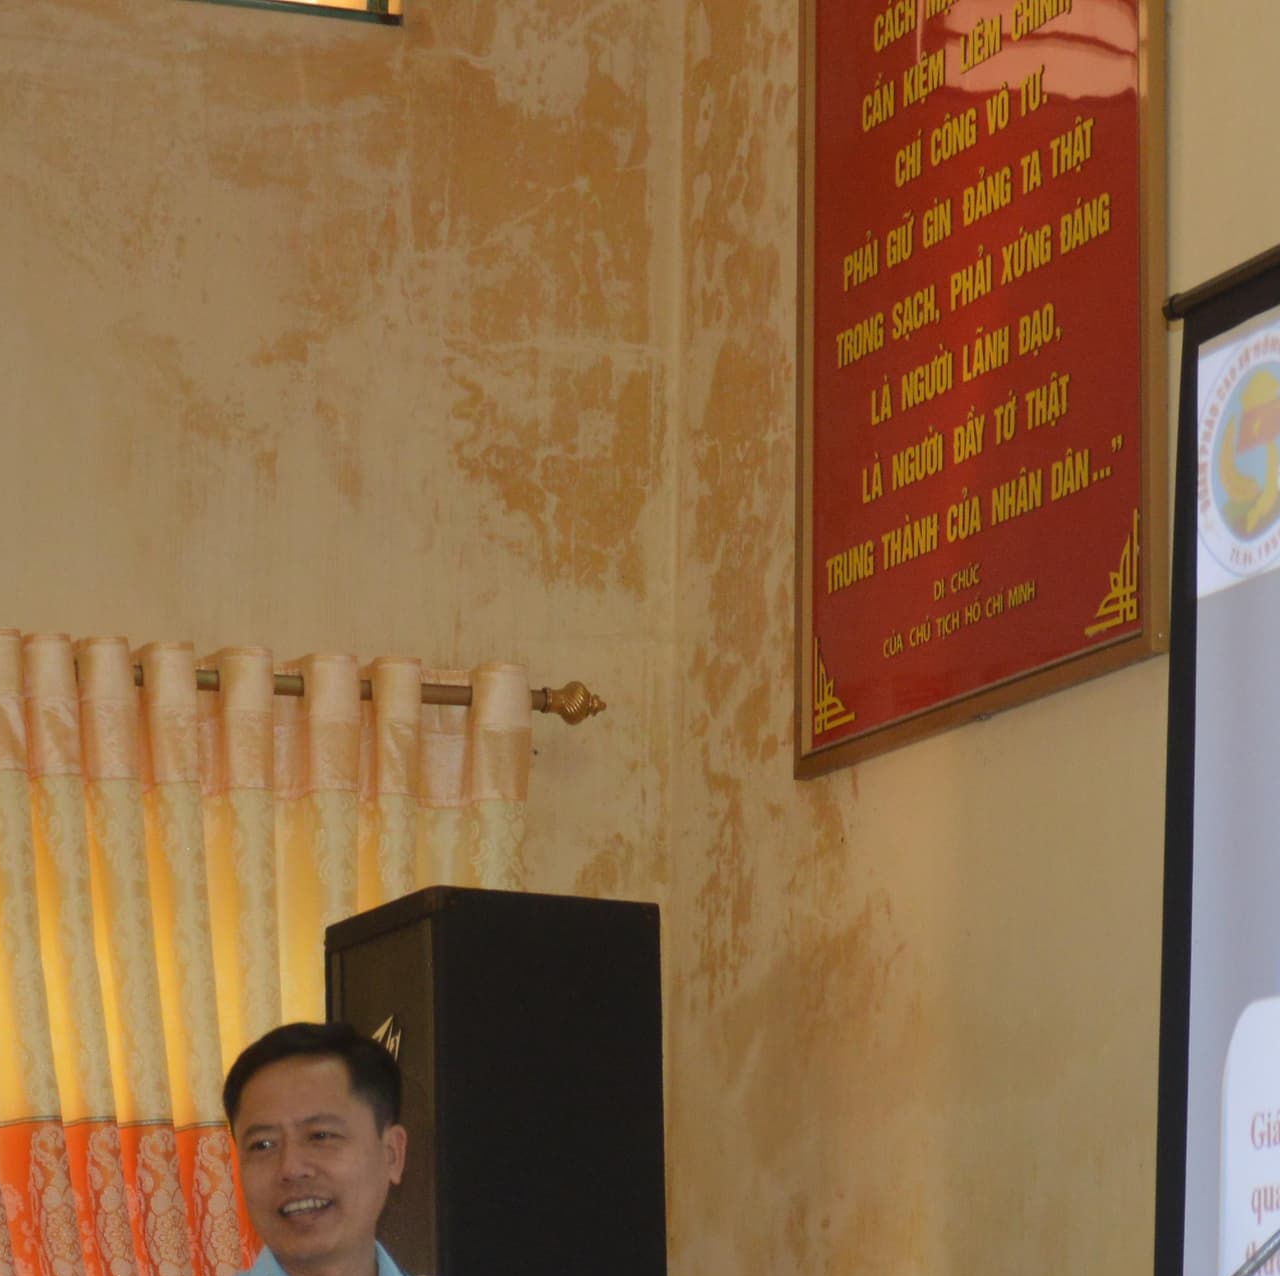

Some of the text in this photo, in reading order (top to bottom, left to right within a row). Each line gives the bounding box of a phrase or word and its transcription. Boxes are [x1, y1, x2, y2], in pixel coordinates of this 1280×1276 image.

[903, 49, 946, 105] KIỆM
[960, 14, 1002, 74] LIÊM
[895, 129, 922, 188] CHÍ
[930, 107, 977, 167] CÔNG
[986, 82, 1010, 136] VÔ
[843, 116, 1095, 292] PHẢI GIỮ GÌN ĐẢNG TA THẬT
[836, 312, 884, 368] TRONG
[950, 245, 992, 312] PHẢI
[1001, 225, 1051, 285] XỨNG
[1060, 193, 1111, 255] ĐÁNG
[871, 374, 892, 426] LÀ
[901, 344, 954, 411] NGƯỜI
[963, 327, 1010, 383] LÃNH
[862, 453, 883, 504] LÀ
[892, 425, 943, 491] NGƯỜI
[994, 390, 1016, 445] TỚ
[1025, 372, 1070, 430] THẬT
[826, 540, 874, 594] TRUNG
[881, 513, 938, 570] THÀNH
[946, 488, 981, 543] CỦA
[991, 467, 1042, 526] NHÂN
[934, 562, 980, 601] DI CHÚC
[1008, 579, 1035, 609] MINH
